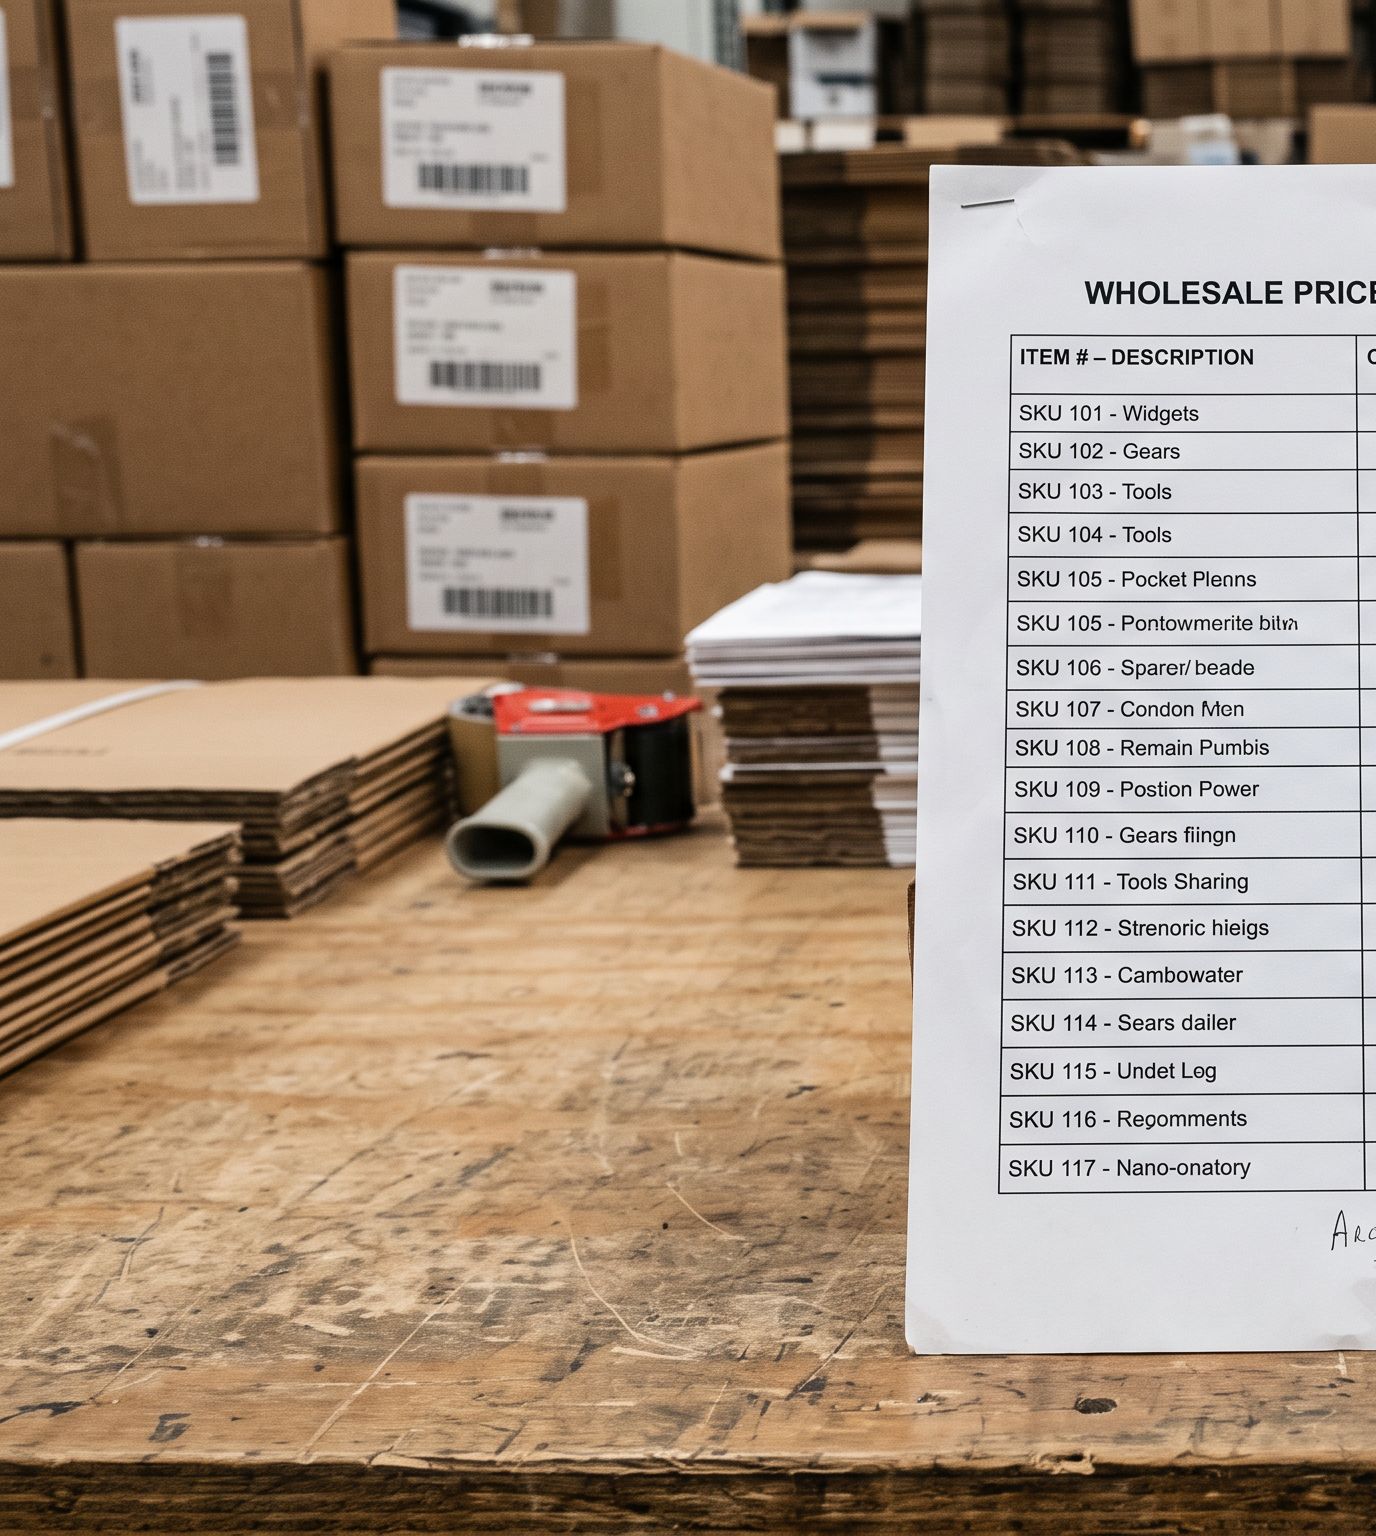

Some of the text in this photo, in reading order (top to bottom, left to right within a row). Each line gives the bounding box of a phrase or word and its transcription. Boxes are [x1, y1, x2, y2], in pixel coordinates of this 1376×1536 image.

[1084, 280, 1284, 305] WHOLESALE
[1020, 348, 1070, 365] ITEM
[1075, 348, 1089, 366] #
[1111, 348, 1254, 366] DESCRIPTION
[1019, 404, 1062, 422] SKU
[1070, 404, 1101, 422] 101
[1122, 404, 1200, 426] Widgets
[1018, 442, 1062, 460] SKU
[1069, 442, 1104, 460] 102
[1122, 442, 1181, 460] Gears
[1018, 482, 1061, 500] SKU
[1069, 482, 1103, 500] 103
[1121, 482, 1172, 500] Tools
[1017, 525, 1061, 543] SKU
[1068, 525, 1103, 543] 104
[1121, 526, 1172, 543] Tools
[1017, 570, 1060, 588] SKU
[1068, 570, 1102, 588] 105
[1122, 570, 1188, 588] Pocket
[1193, 570, 1257, 588] Plenns
[1016, 614, 1060, 632] SKU
[1067, 614, 1102, 632] 105
[1016, 659, 1060, 677] SKU
[1067, 659, 1102, 677] 106
[1195, 658, 1255, 676] beade
[1015, 700, 1059, 718] SKU
[1066, 700, 1102, 718] 107
[1120, 700, 1194, 718] Condon
[1015, 739, 1059, 757] SKU
[1066, 739, 1101, 757] 108
[1120, 739, 1193, 757] Remain
[1199, 738, 1270, 756] Pumbis
[1014, 780, 1058, 798] SKU
[1065, 780, 1101, 798] 109
[1120, 780, 1192, 798] Postion
[1199, 780, 1260, 798] Power
[1013, 826, 1058, 844] SKU
[1065, 826, 1099, 844] 110
[1119, 826, 1178, 844] Gears
[1013, 872, 1057, 891] SKU
[1064, 872, 1095, 891] 111
[1116, 872, 1168, 891] Tools
[1174, 872, 1249, 894] Sharing
[1012, 919, 1056, 937] SKU
[1064, 919, 1098, 937] 112
[1118, 918, 1206, 937] Strenoric
[1011, 966, 1056, 985] SKU
[1064, 966, 1098, 984] 113
[1117, 966, 1244, 984] Cambowater
[1010, 1014, 1055, 1032] SKU
[1063, 1013, 1098, 1032] 114
[1117, 1013, 1175, 1032] Sears
[1181, 1013, 1237, 1031] dailer
[1010, 1062, 1054, 1081] SKU
[1063, 1062, 1097, 1080] 115
[1117, 1061, 1176, 1080] Undet
[1009, 1110, 1054, 1129] SKU
[1062, 1110, 1097, 1129] 116
[1008, 1159, 1053, 1178] SKU
[1062, 1159, 1096, 1177] 117
[1117, 1158, 1252, 1180] Nano-onatory
